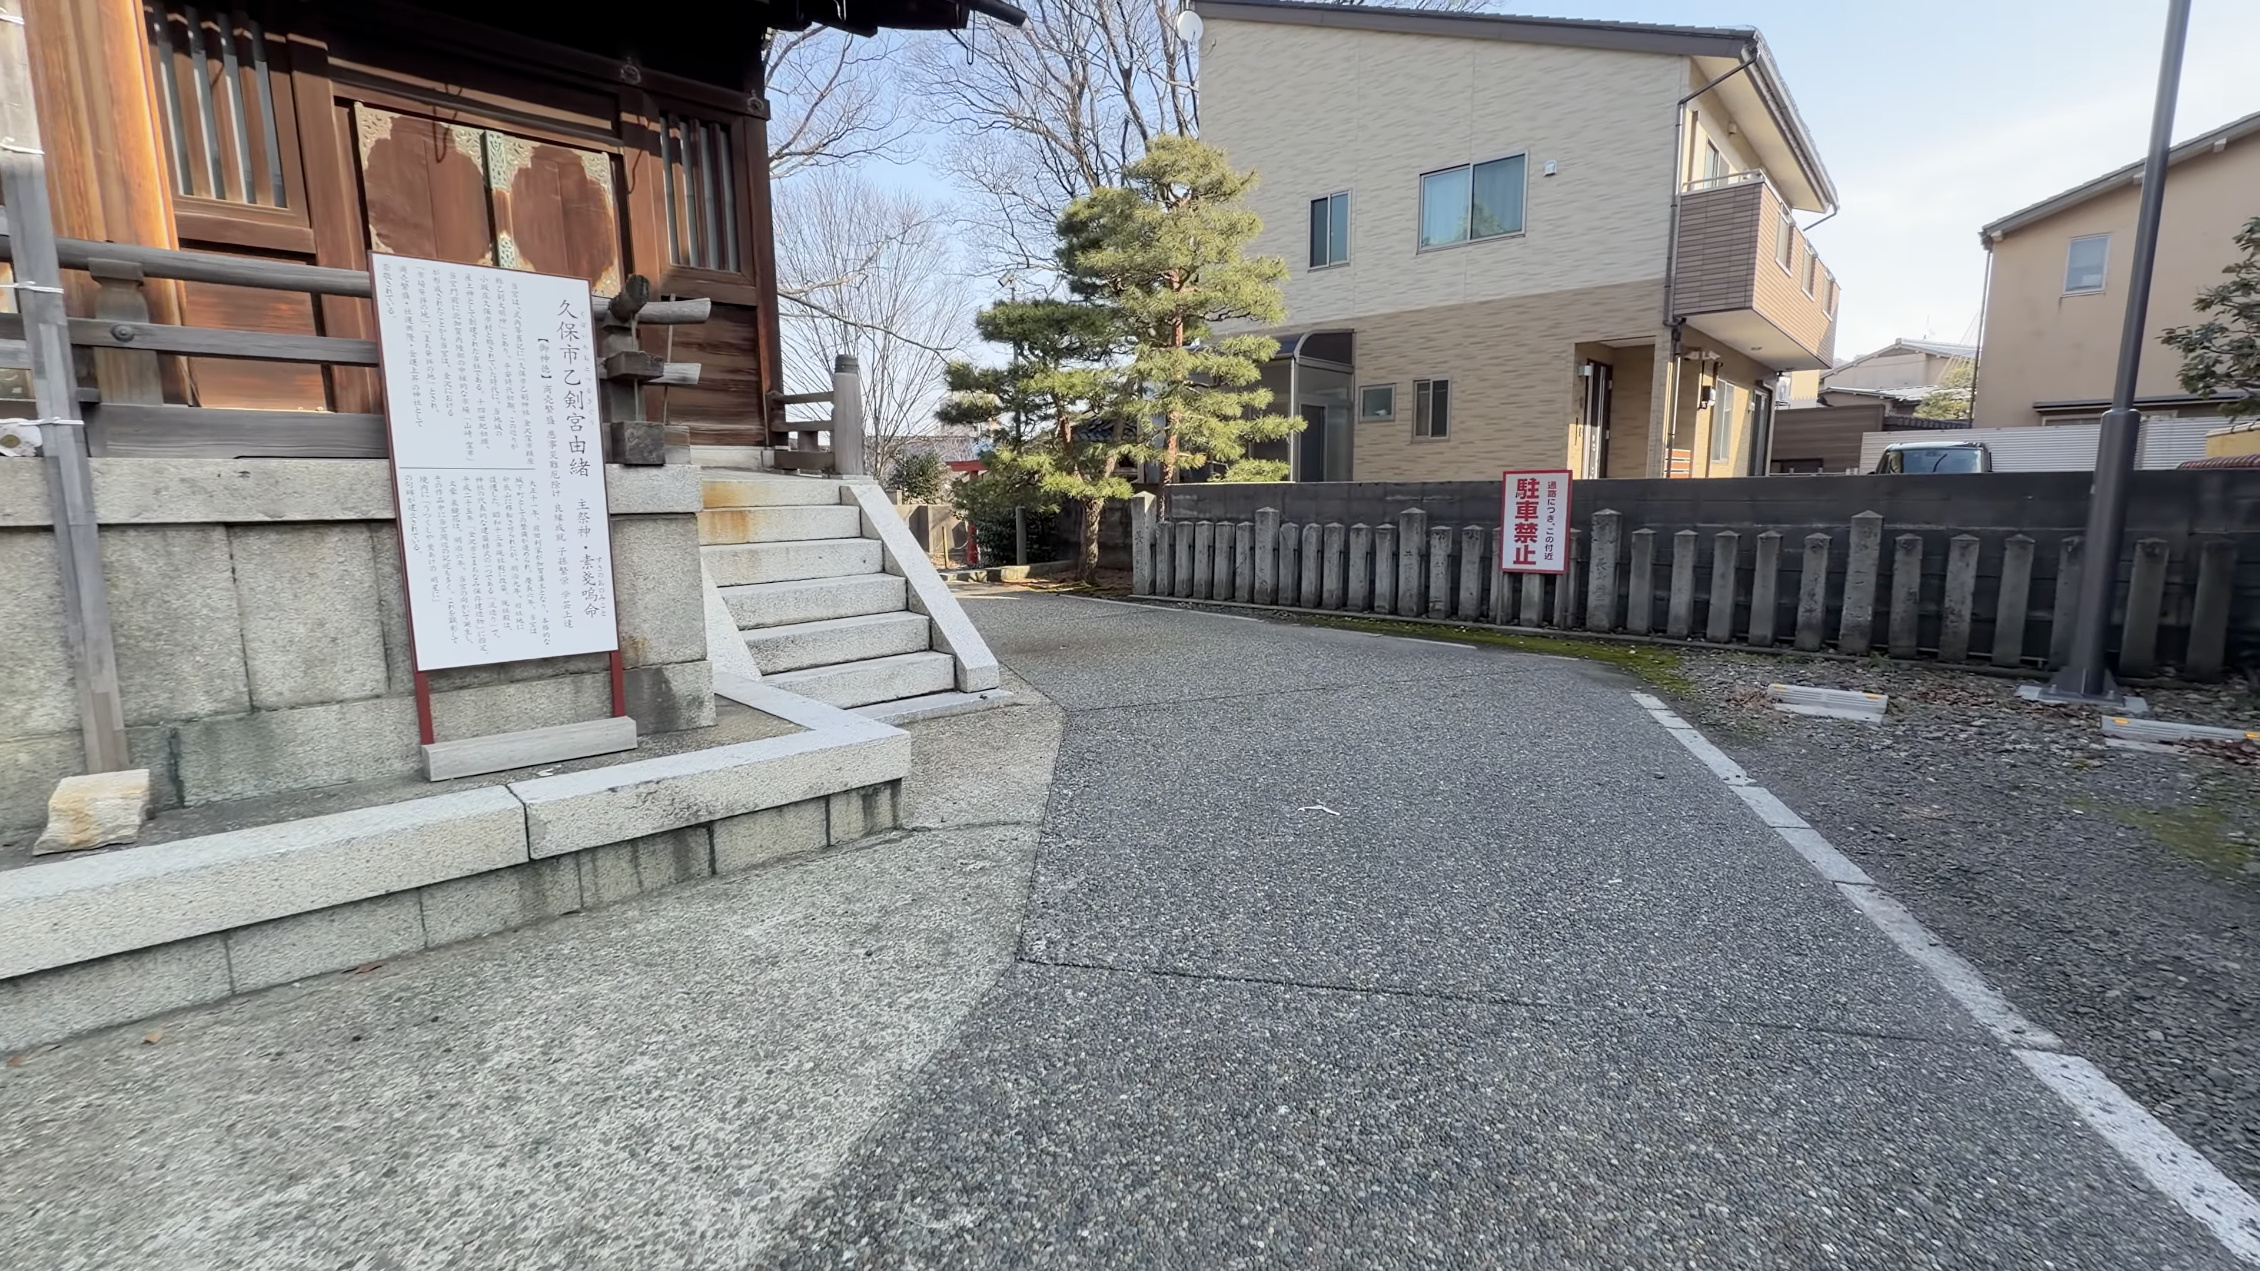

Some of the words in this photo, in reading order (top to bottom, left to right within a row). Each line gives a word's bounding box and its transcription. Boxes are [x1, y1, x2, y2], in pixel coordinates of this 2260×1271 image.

[537, 337, 552, 378] 【御神徳】
[542, 384, 555, 424] 商売繁盛
[555, 298, 590, 477] 久保市乙剣宮由緒
[1513, 478, 1540, 565] 駐車禁止
[556, 546, 569, 585] 子孫繁栄
